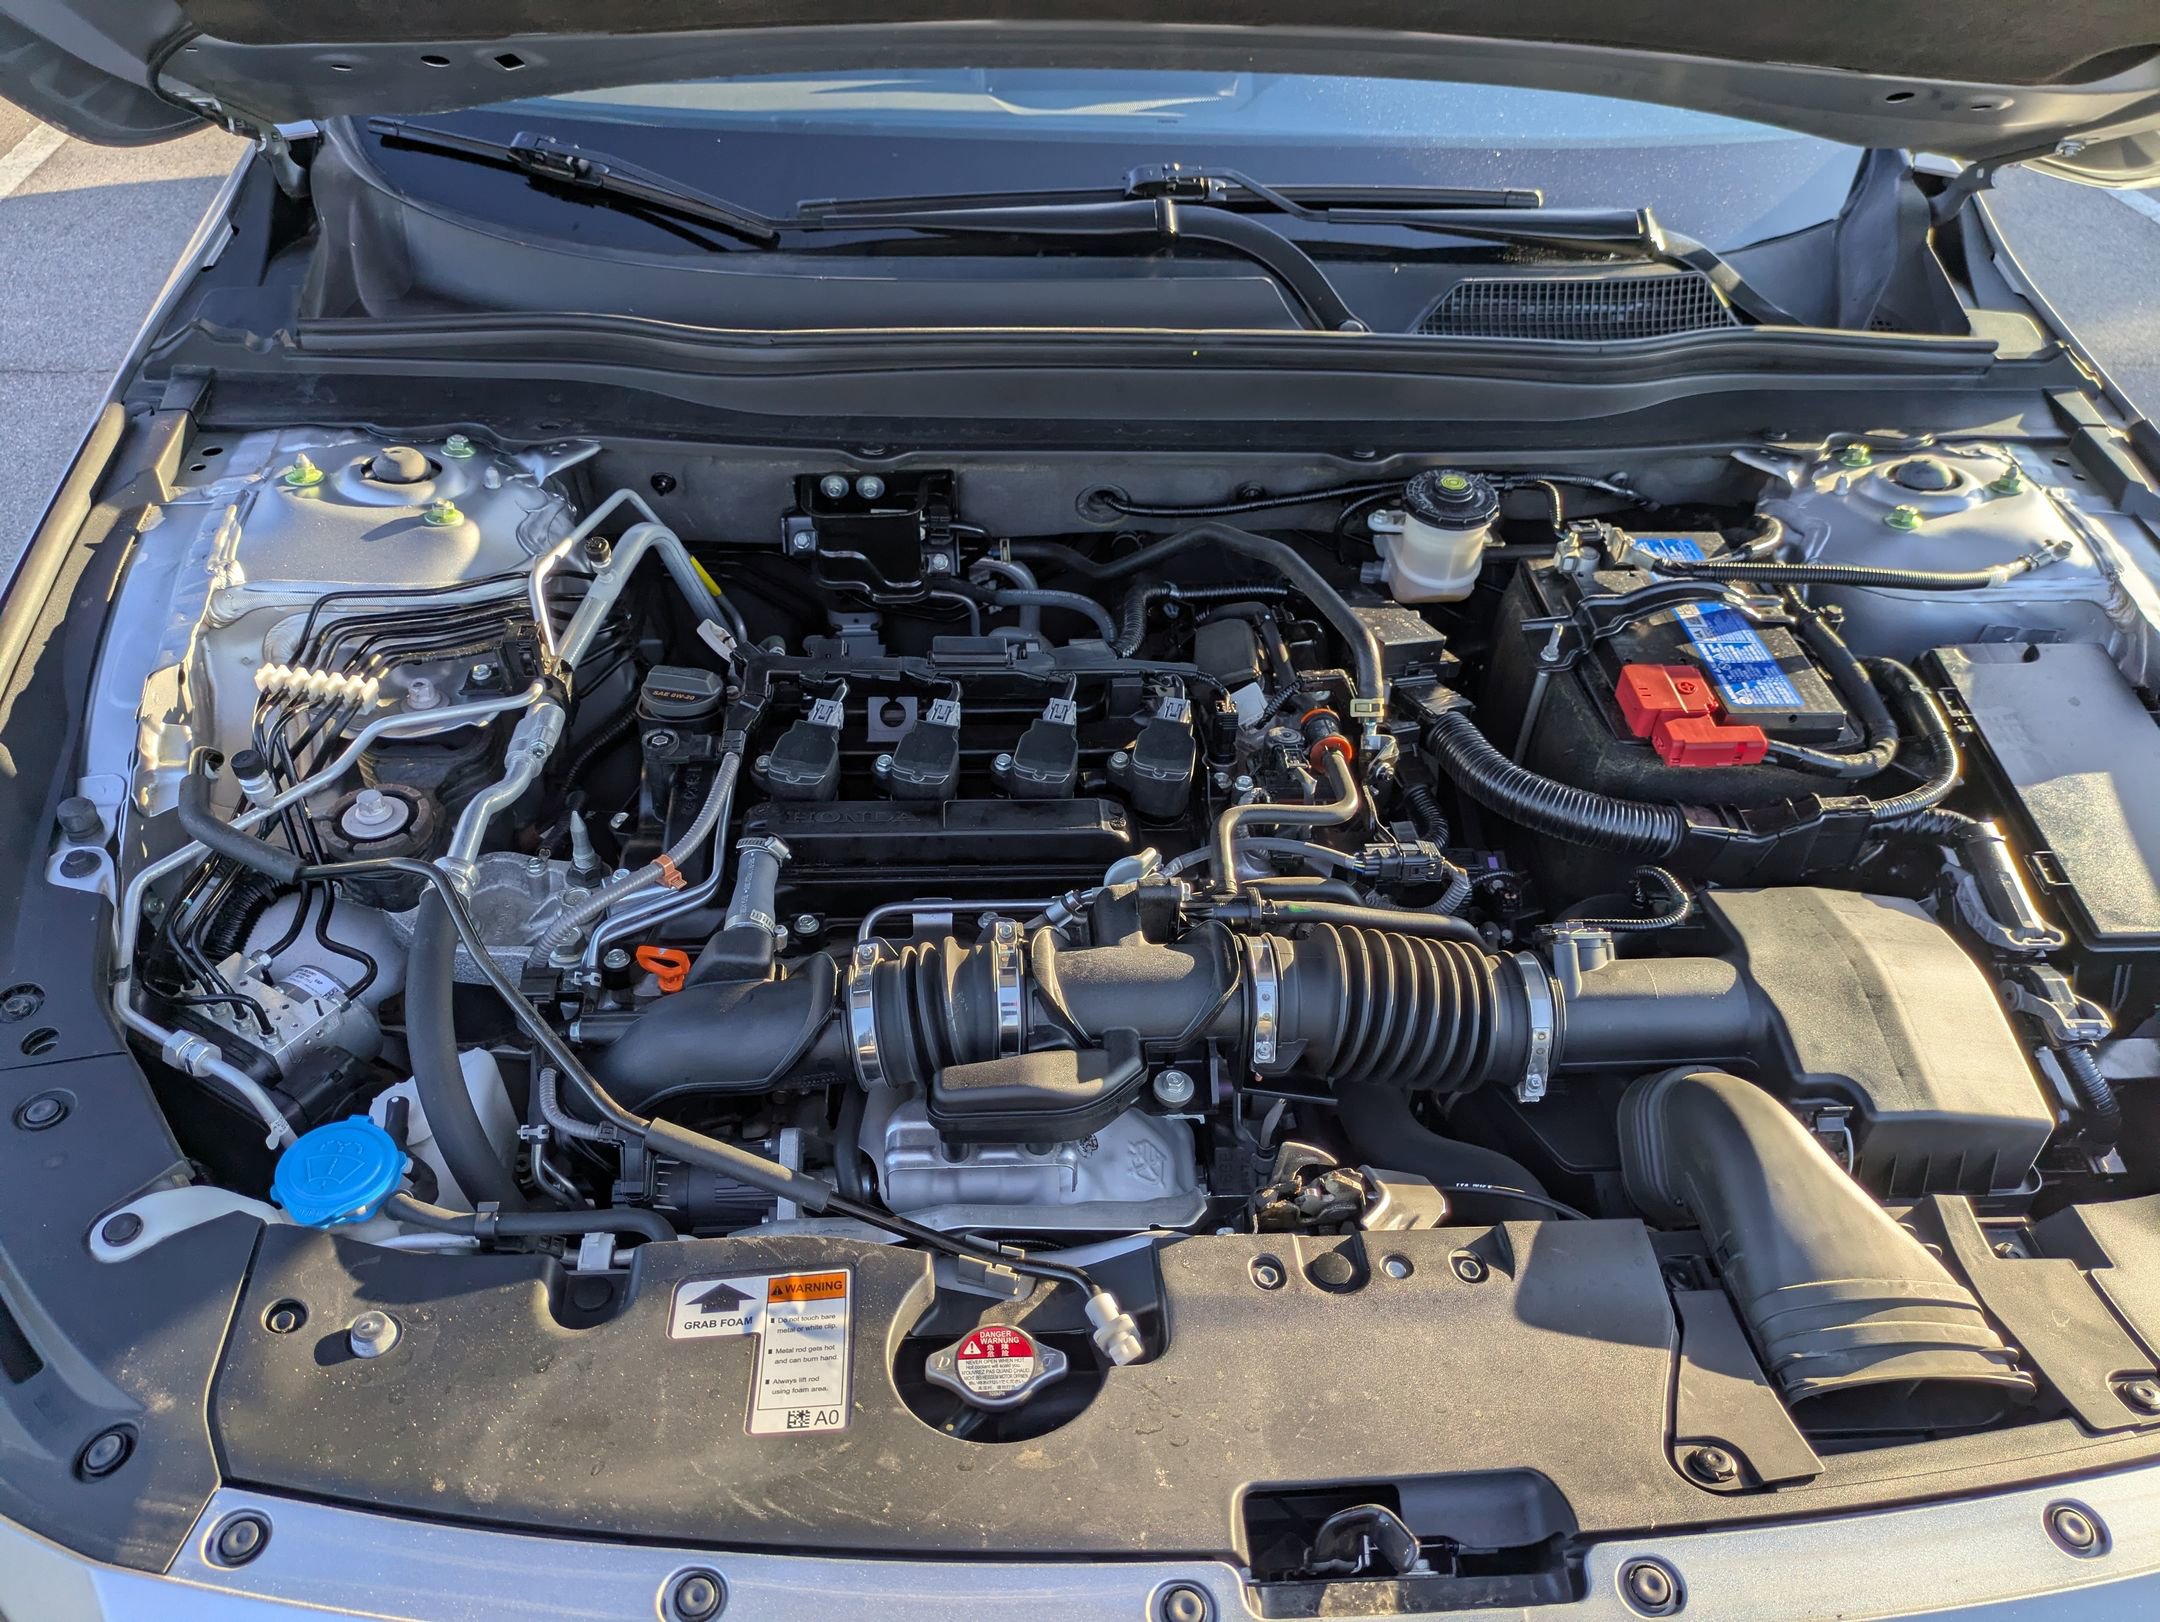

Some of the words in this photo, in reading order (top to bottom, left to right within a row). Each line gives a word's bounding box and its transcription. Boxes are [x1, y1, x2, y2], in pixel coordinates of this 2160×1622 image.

[782, 810, 921, 824] HONDA
[785, 1280, 843, 1294] WARNING
[684, 1320, 717, 1330] GRAB
[720, 1316, 753, 1328] FOAM
[777, 1326, 796, 1334] metal
[805, 1324, 823, 1332] white
[824, 1323, 838, 1331] clip.
[980, 1330, 1012, 1338] DANGER
[980, 1337, 1020, 1345] WARNUNG
[808, 1345, 823, 1353] gets
[772, 1377, 797, 1385] Always
[771, 1388, 791, 1396] using
[813, 1409, 840, 1426] A0
